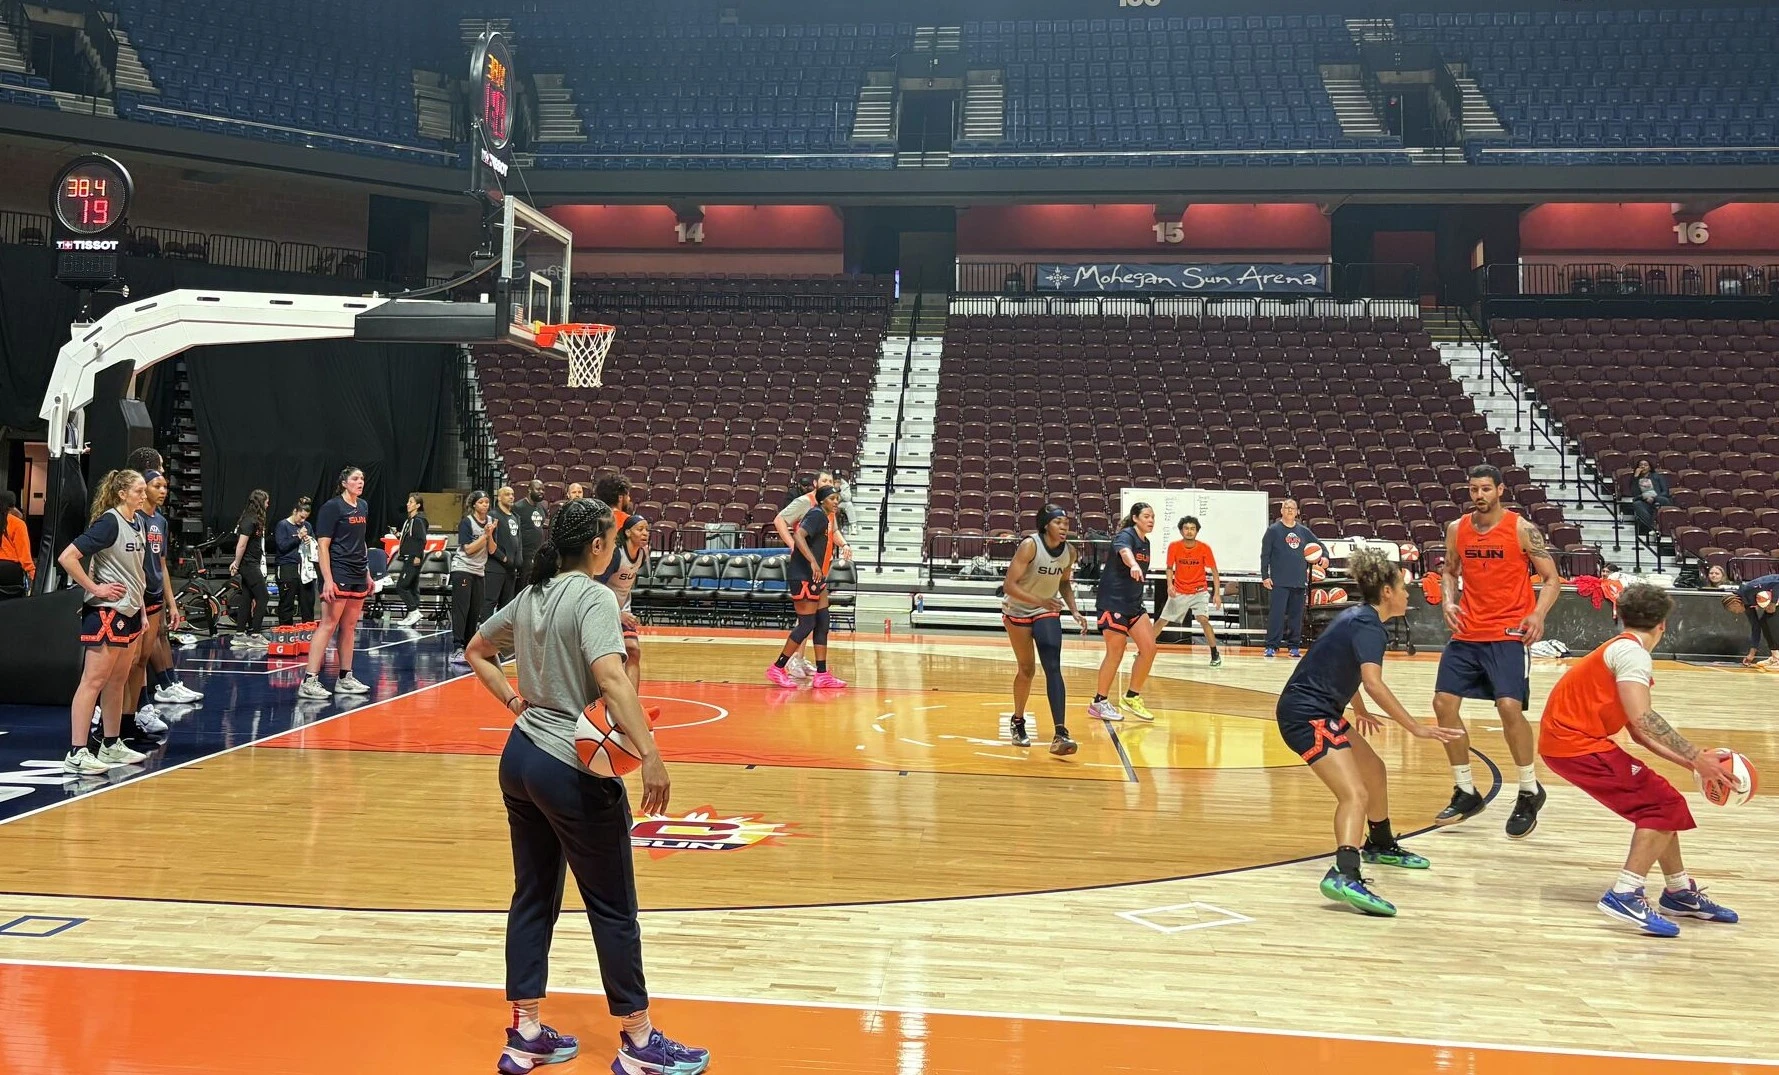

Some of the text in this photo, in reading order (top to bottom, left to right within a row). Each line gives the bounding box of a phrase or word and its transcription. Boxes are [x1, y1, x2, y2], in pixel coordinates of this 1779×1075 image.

[67, 179, 106, 197] 38.4
[83, 200, 109, 224] 19
[674, 222, 705, 243] 14
[1152, 221, 1185, 244] 15
[1672, 221, 1710, 245] 16
[74, 240, 119, 250] TISSOT
[1073, 264, 1318, 291] Mohegan Sun Arena
[125, 542, 145, 552] SU
[1464, 549, 1504, 559] SUN
[276, 645, 284, 654] G
[630, 839, 725, 850] SUN
